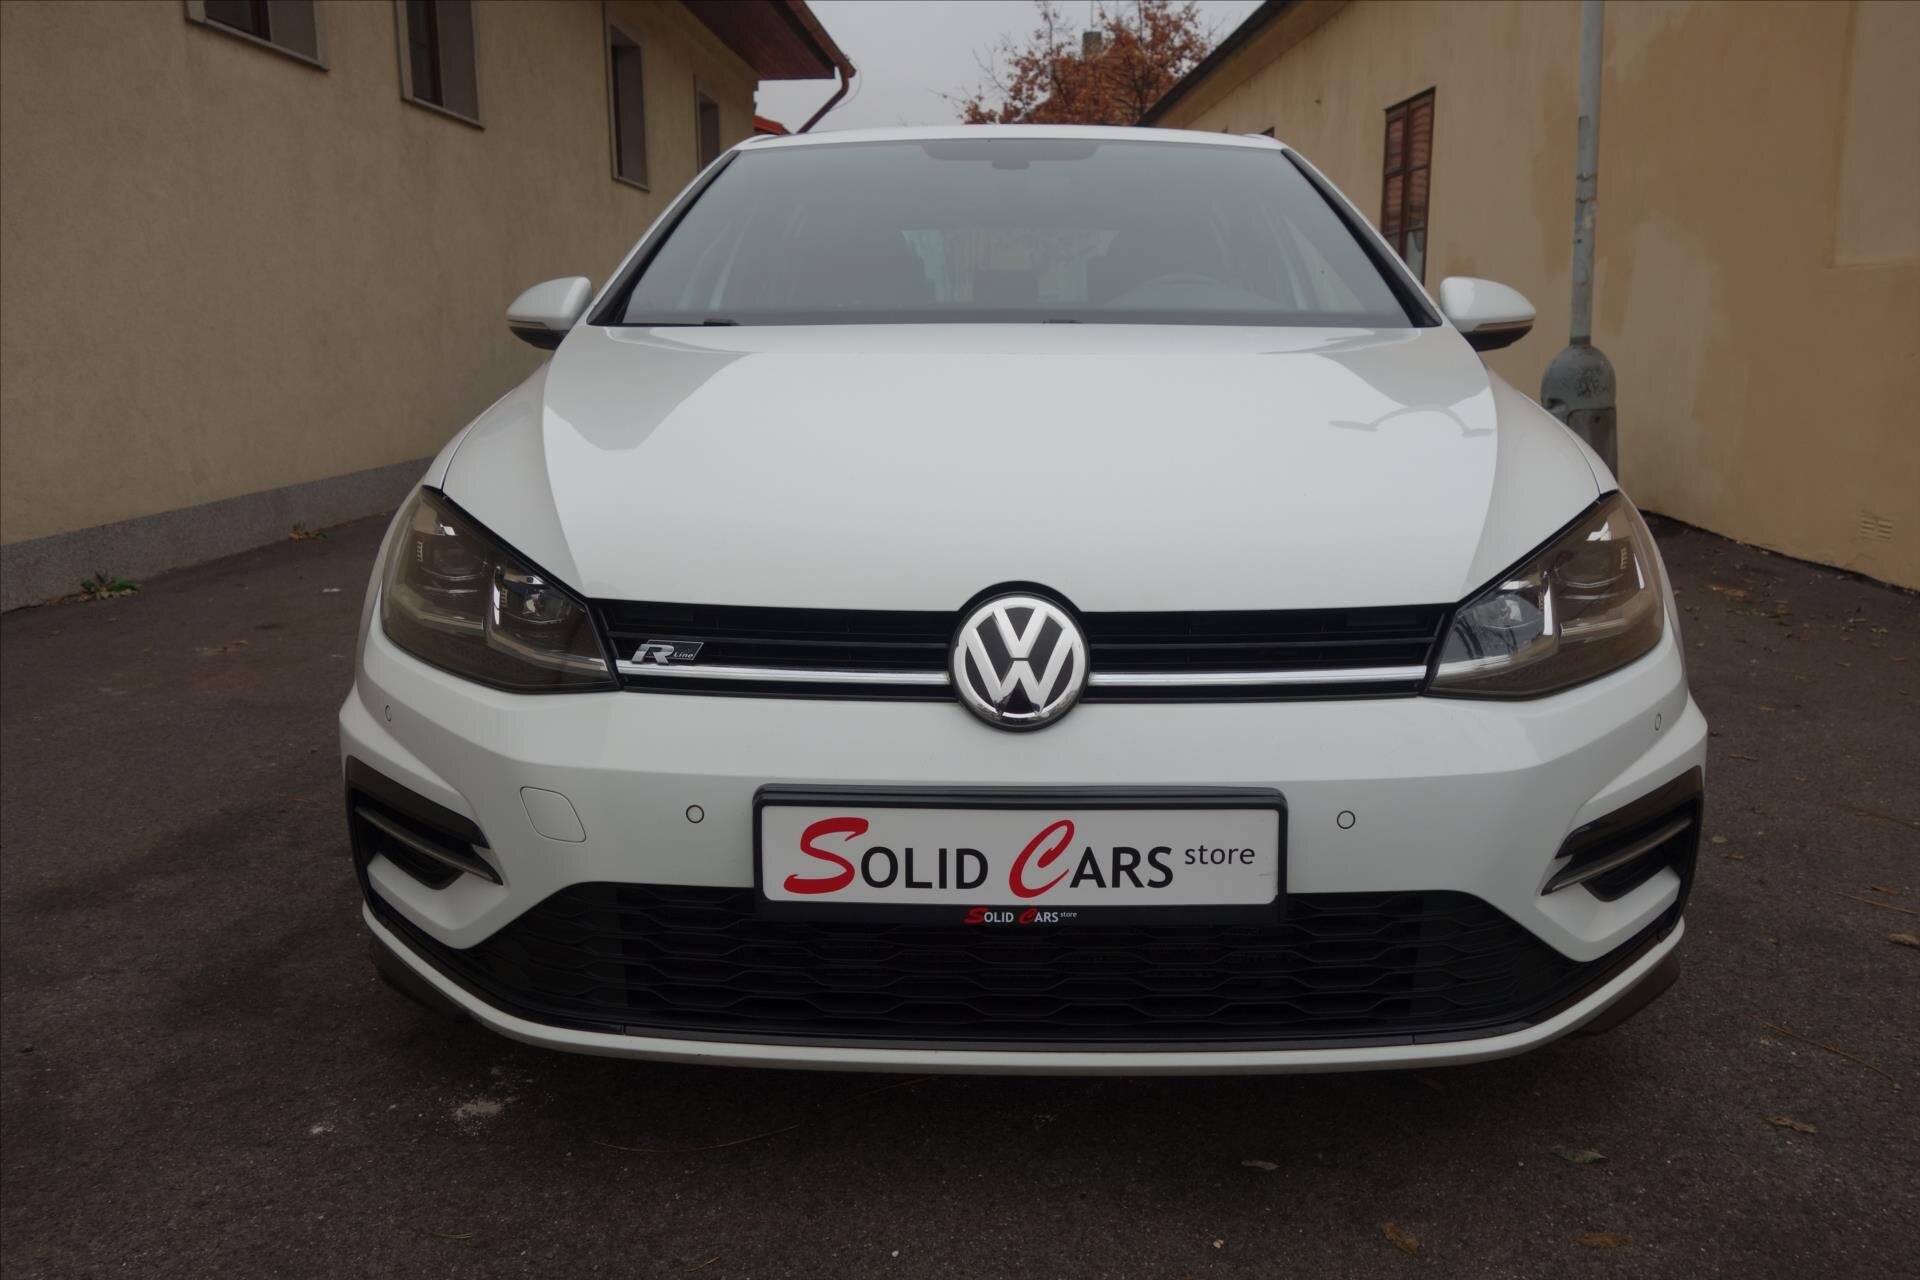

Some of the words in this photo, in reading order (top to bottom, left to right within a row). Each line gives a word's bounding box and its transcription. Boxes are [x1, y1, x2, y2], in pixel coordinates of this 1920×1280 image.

[631, 643, 672, 665] R
[960, 602, 1079, 715] VW
[783, 816, 989, 894] SOLID
[1008, 819, 1174, 898] CARS
[1184, 844, 1256, 865] store
[964, 907, 1014, 924] SOLID
[1019, 908, 1059, 924] CARS
